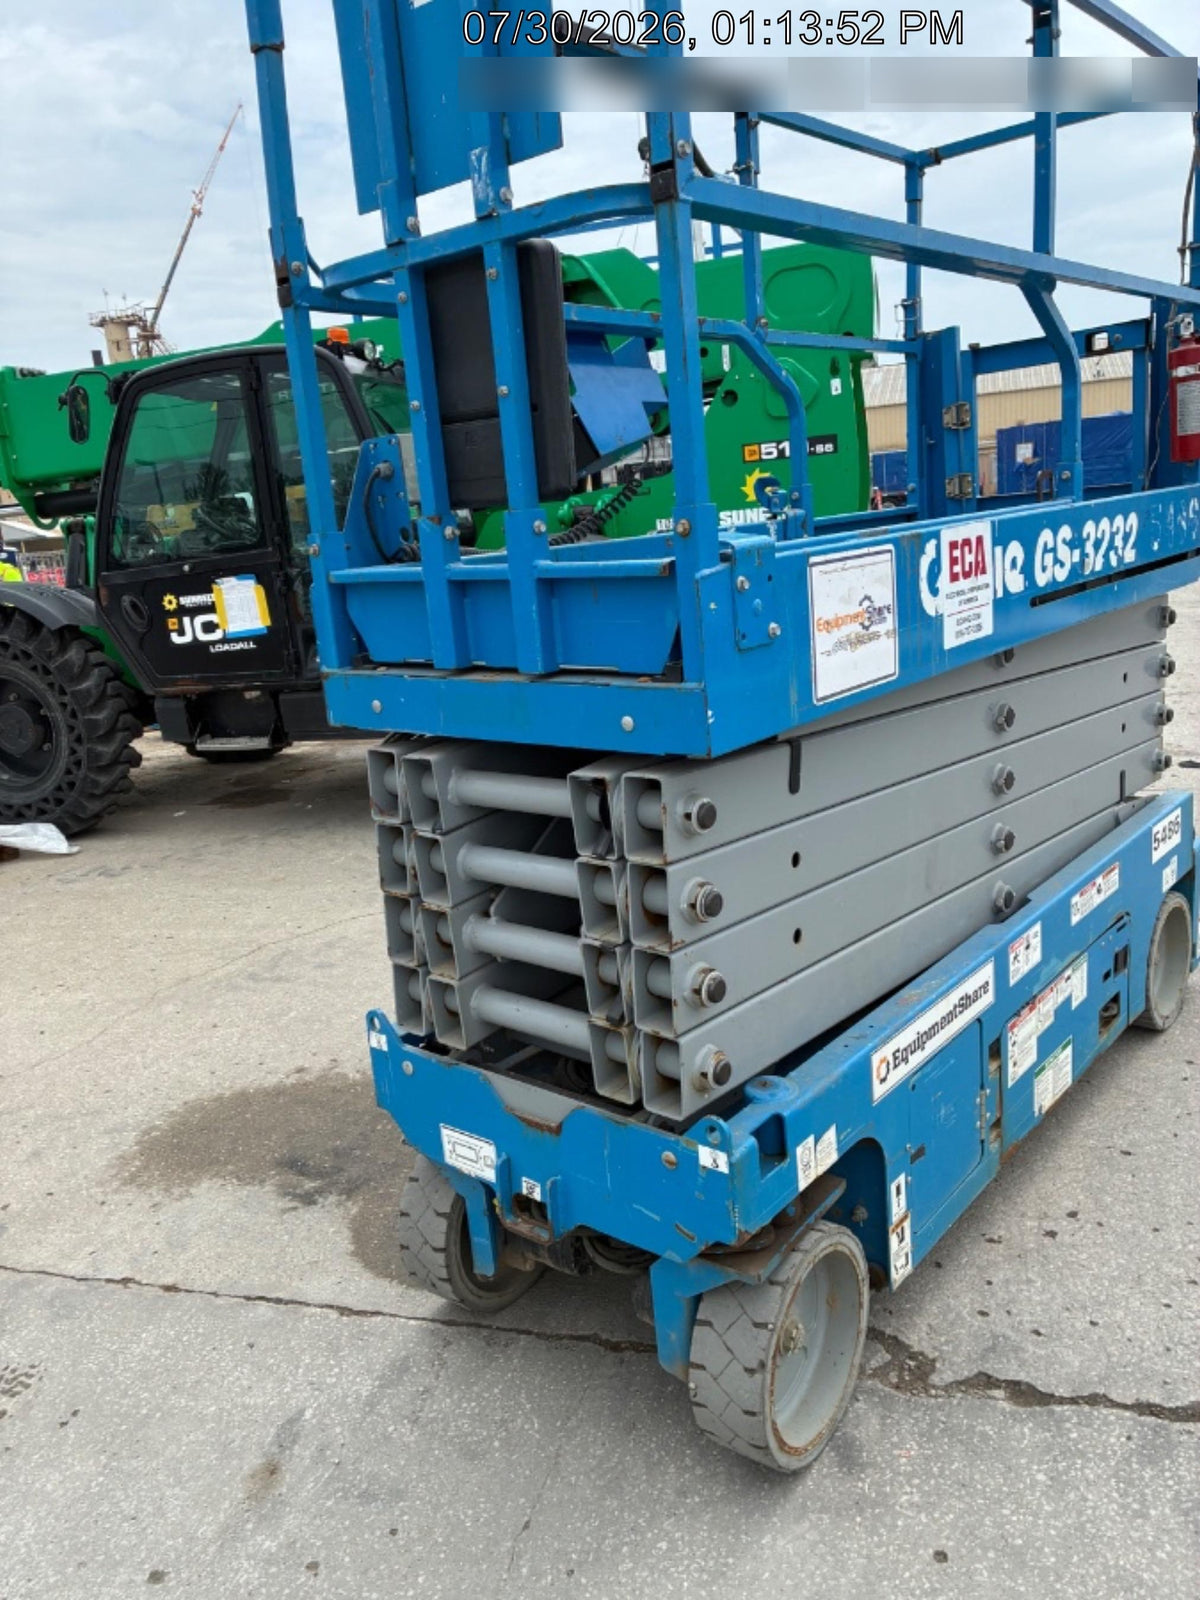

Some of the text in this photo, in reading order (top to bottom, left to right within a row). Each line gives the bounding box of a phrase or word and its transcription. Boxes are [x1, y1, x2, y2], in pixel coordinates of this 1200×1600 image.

[949, 535, 987, 584] ECA
[1034, 511, 1139, 588] GS-3232
[169, 613, 224, 644] JC
[209, 641, 257, 653] LOADALL
[892, 979, 990, 1072] EquipmentShare
